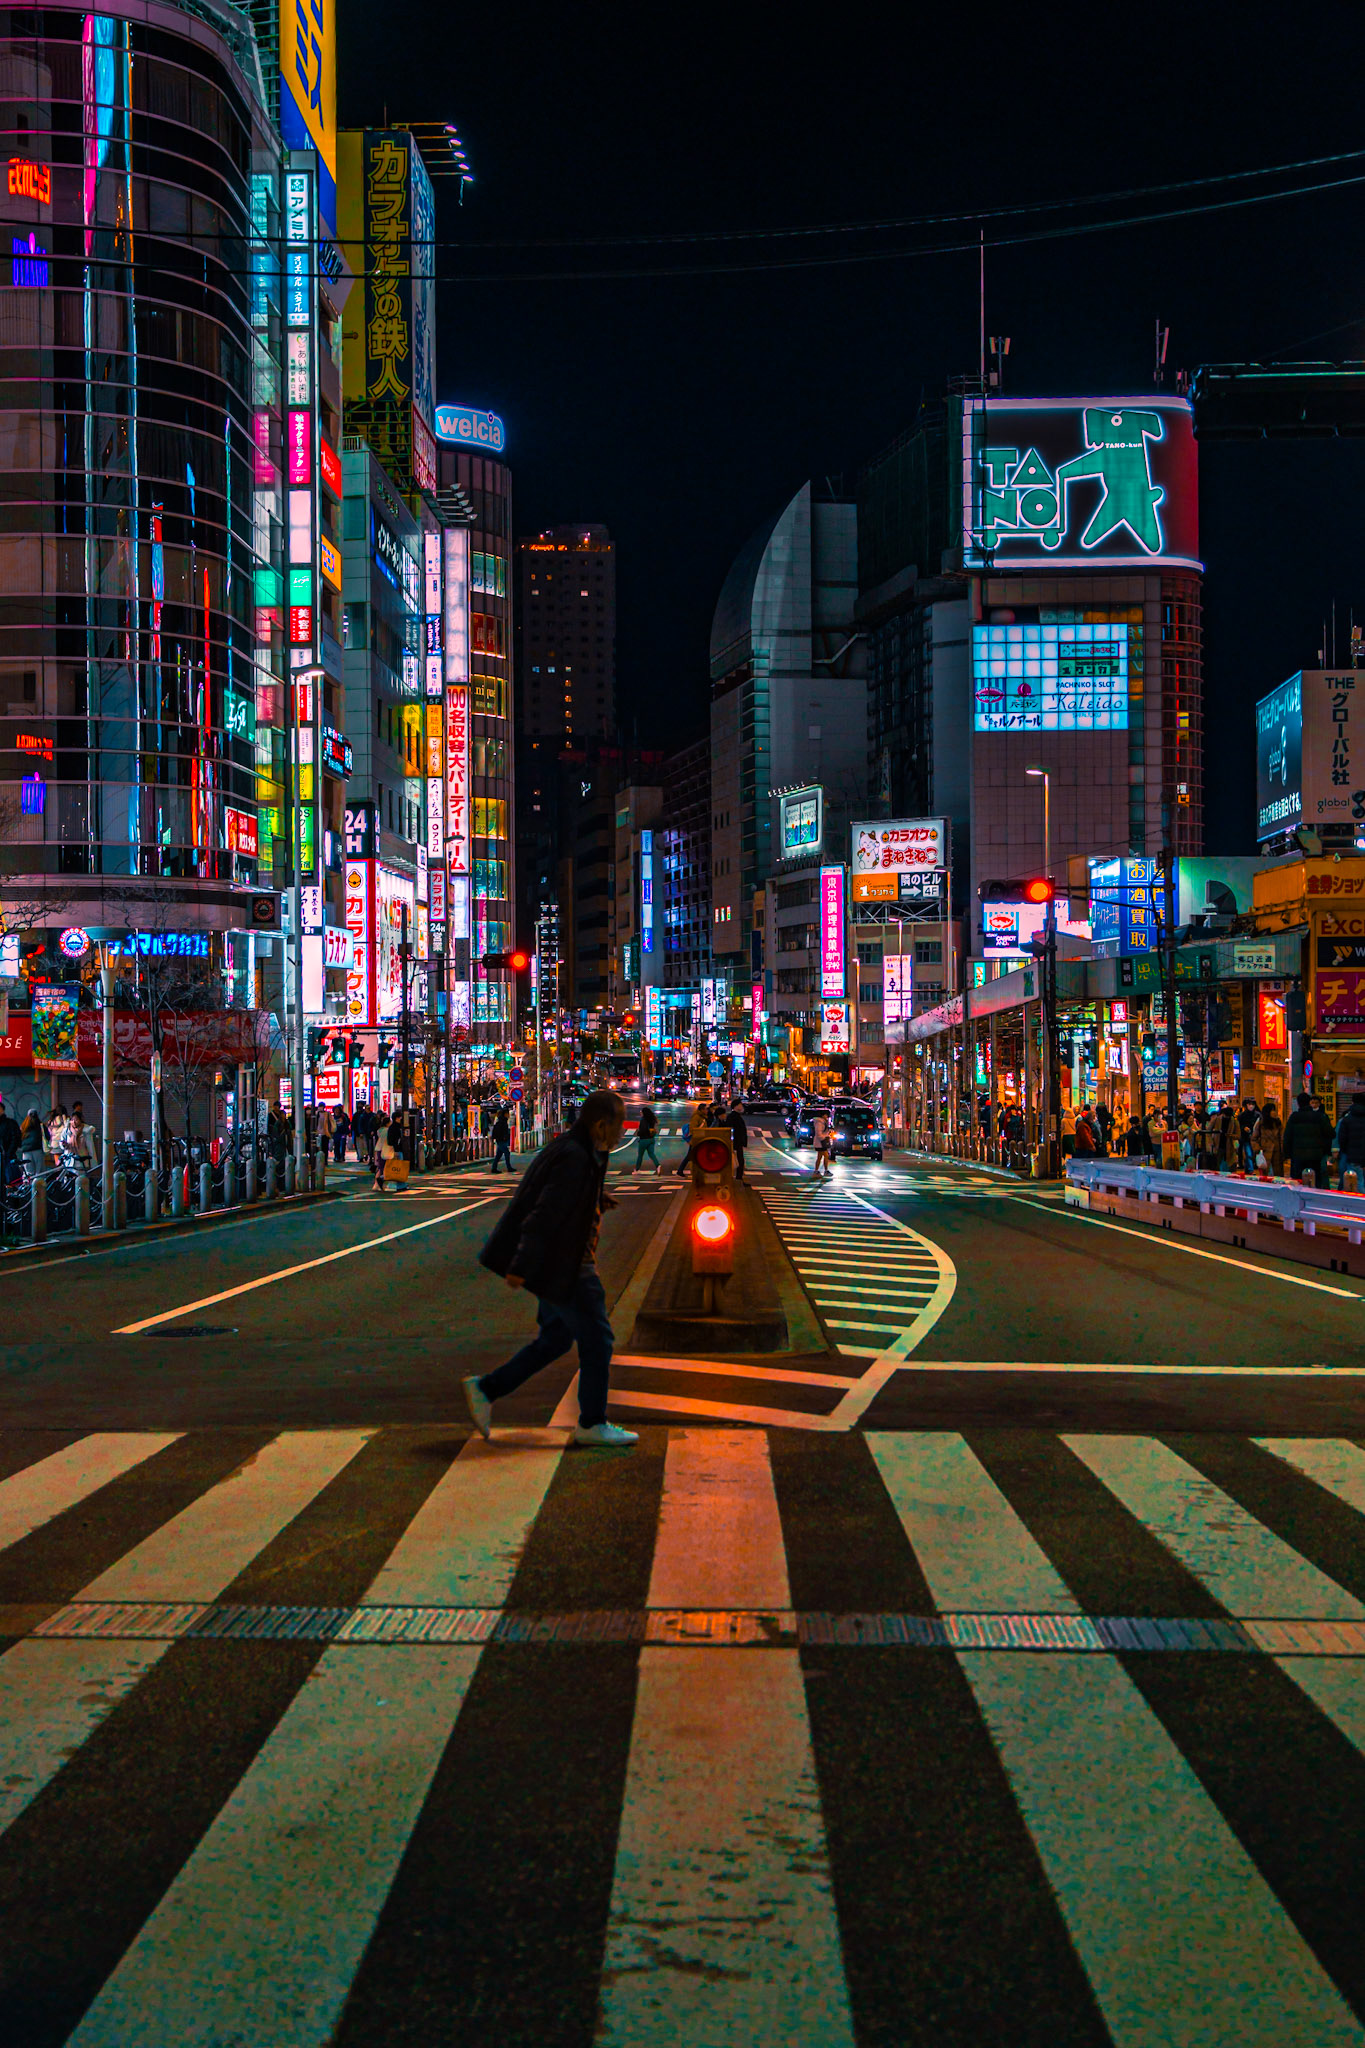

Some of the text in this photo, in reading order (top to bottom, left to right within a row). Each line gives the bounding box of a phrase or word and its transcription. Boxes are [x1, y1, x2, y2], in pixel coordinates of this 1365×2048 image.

[368, 140, 409, 399] カラオケの鉄人
[437, 414, 501, 446] welcia
[1105, 442, 1143, 450] TANO-kun
[298, 608, 310, 641] 美容室
[1056, 681, 1092, 689] PACHINKO
[1325, 677, 1356, 689] THE
[1048, 691, 1123, 711] Kaleido
[999, 714, 1041, 727] ルノアール
[1331, 693, 1350, 786] グローバル社
[1317, 798, 1350, 814] global
[345, 809, 367, 834] 24
[889, 829, 930, 842] カラオケ
[347, 835, 363, 853] H
[882, 846, 938, 868] まねきねこ
[900, 873, 941, 887] 隣のビル
[431, 872, 443, 917] カラオケ
[924, 887, 938, 896] 4F
[1130, 863, 1147, 947] お酒買取
[304, 926, 314, 934] B1
[1321, 920, 1365, 935] EXC
[833, 1042, 847, 1052] すぐ
